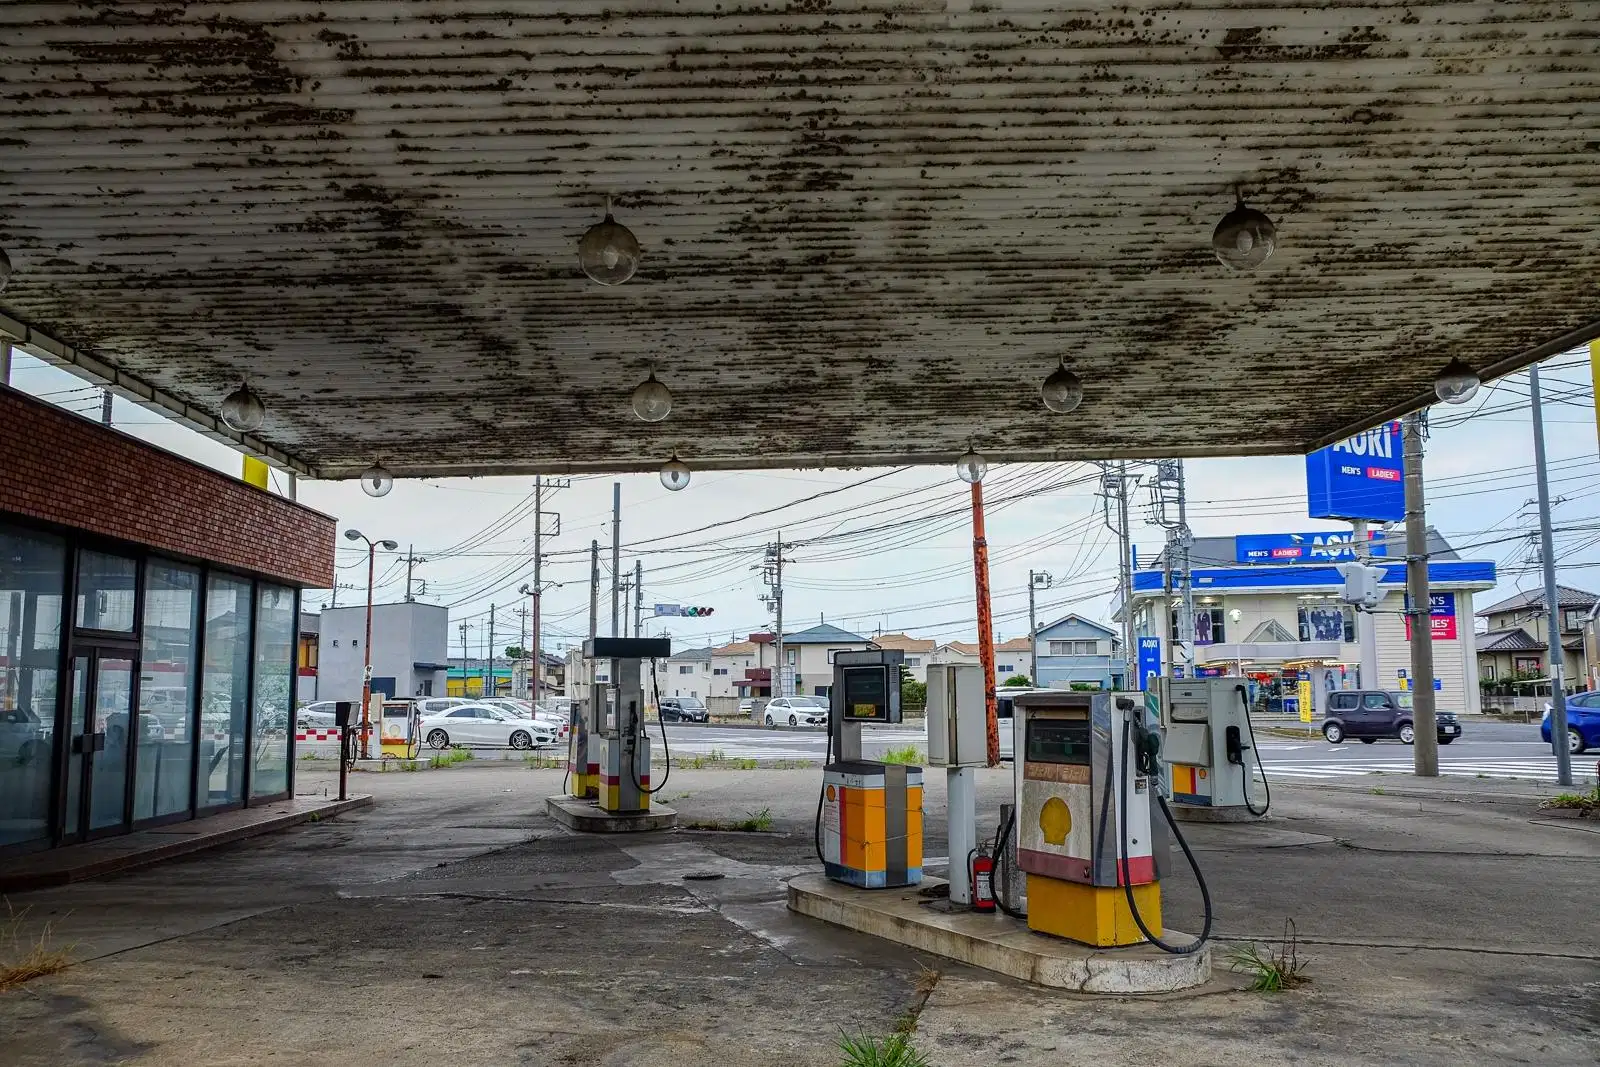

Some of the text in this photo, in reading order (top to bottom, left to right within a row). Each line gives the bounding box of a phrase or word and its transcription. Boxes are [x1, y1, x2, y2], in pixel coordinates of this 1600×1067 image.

[1341, 465, 1395, 479] MEN'S LADIES'
[1310, 534, 1357, 558] AOK
[1429, 596, 1445, 605] N'S
[1431, 619, 1449, 628] IES'
[1142, 640, 1158, 648] AOKI
